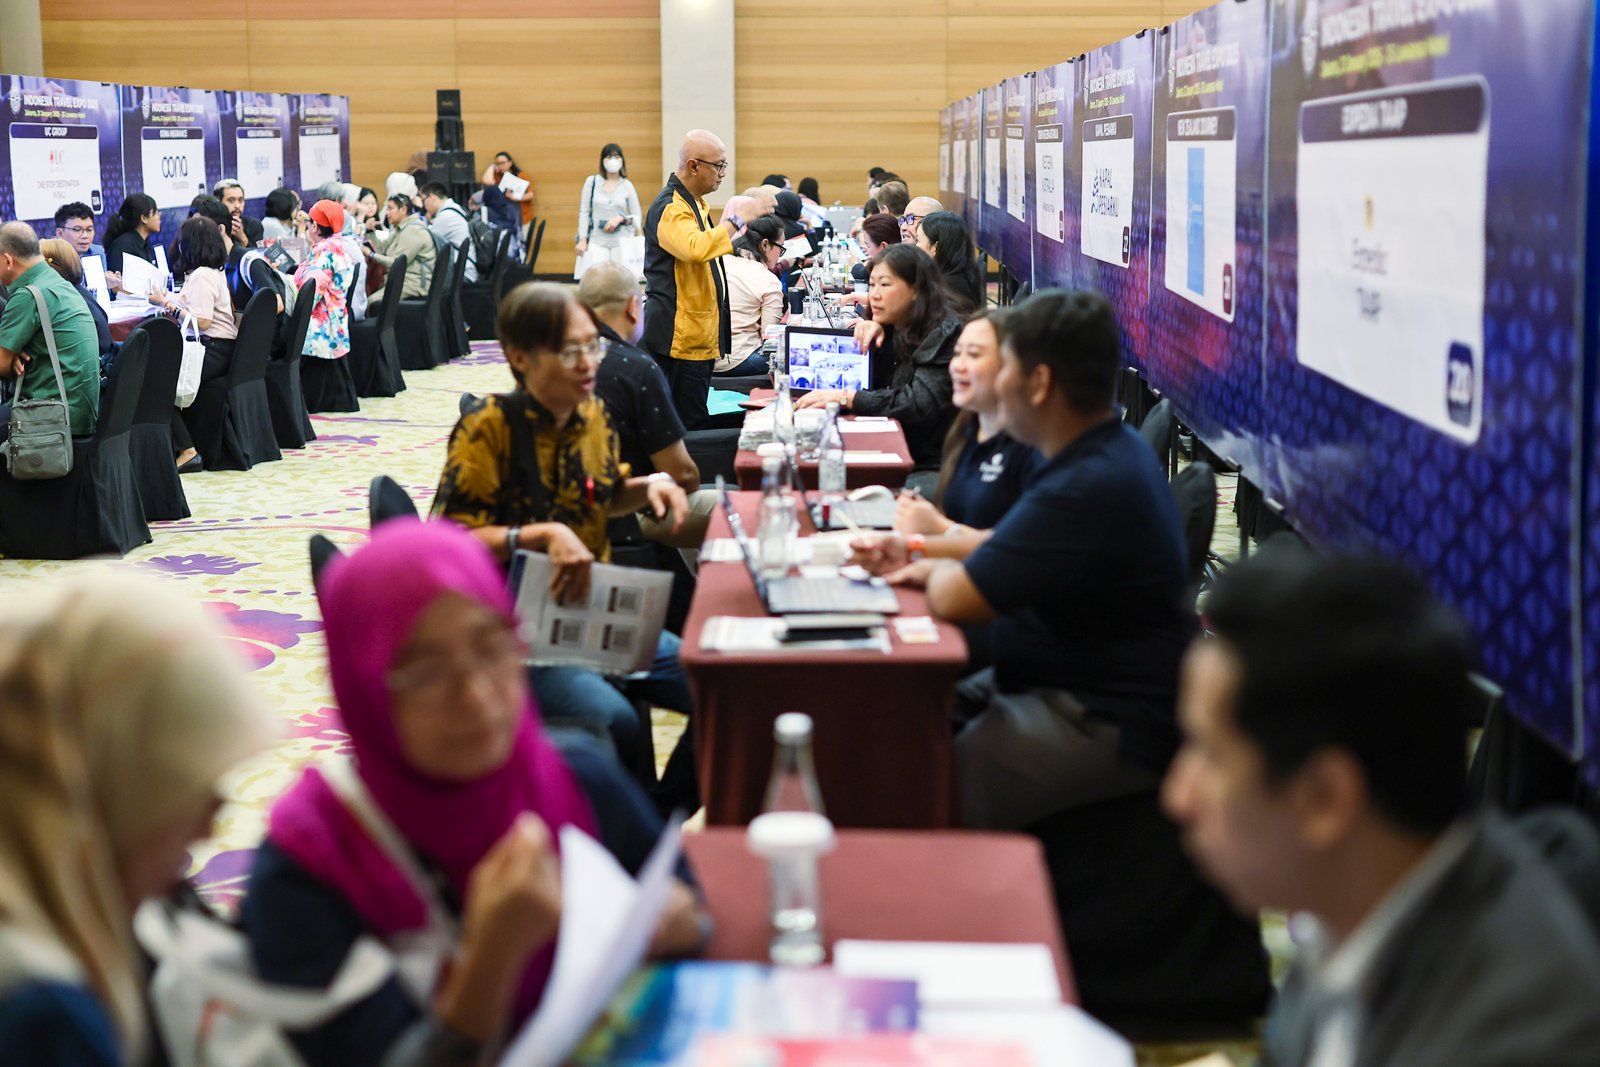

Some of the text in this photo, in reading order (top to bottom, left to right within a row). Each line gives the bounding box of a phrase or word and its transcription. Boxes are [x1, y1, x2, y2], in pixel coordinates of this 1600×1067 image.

[1320, 4, 1371, 48] INDONESIA
[1090, 76, 1104, 94] INDONESIA
[1105, 72, 1116, 89] TRAVEL
[1117, 70, 1125, 87] EXPO
[24, 94, 52, 107] INDONESIA
[53, 96, 73, 109] TRAVEL
[74, 98, 87, 109] EXPO
[152, 103, 171, 112] INDONESIA
[44, 127, 68, 137] UC GROUP
[1099, 167, 1112, 189] KAPAL
[1450, 359, 1473, 402] 20
